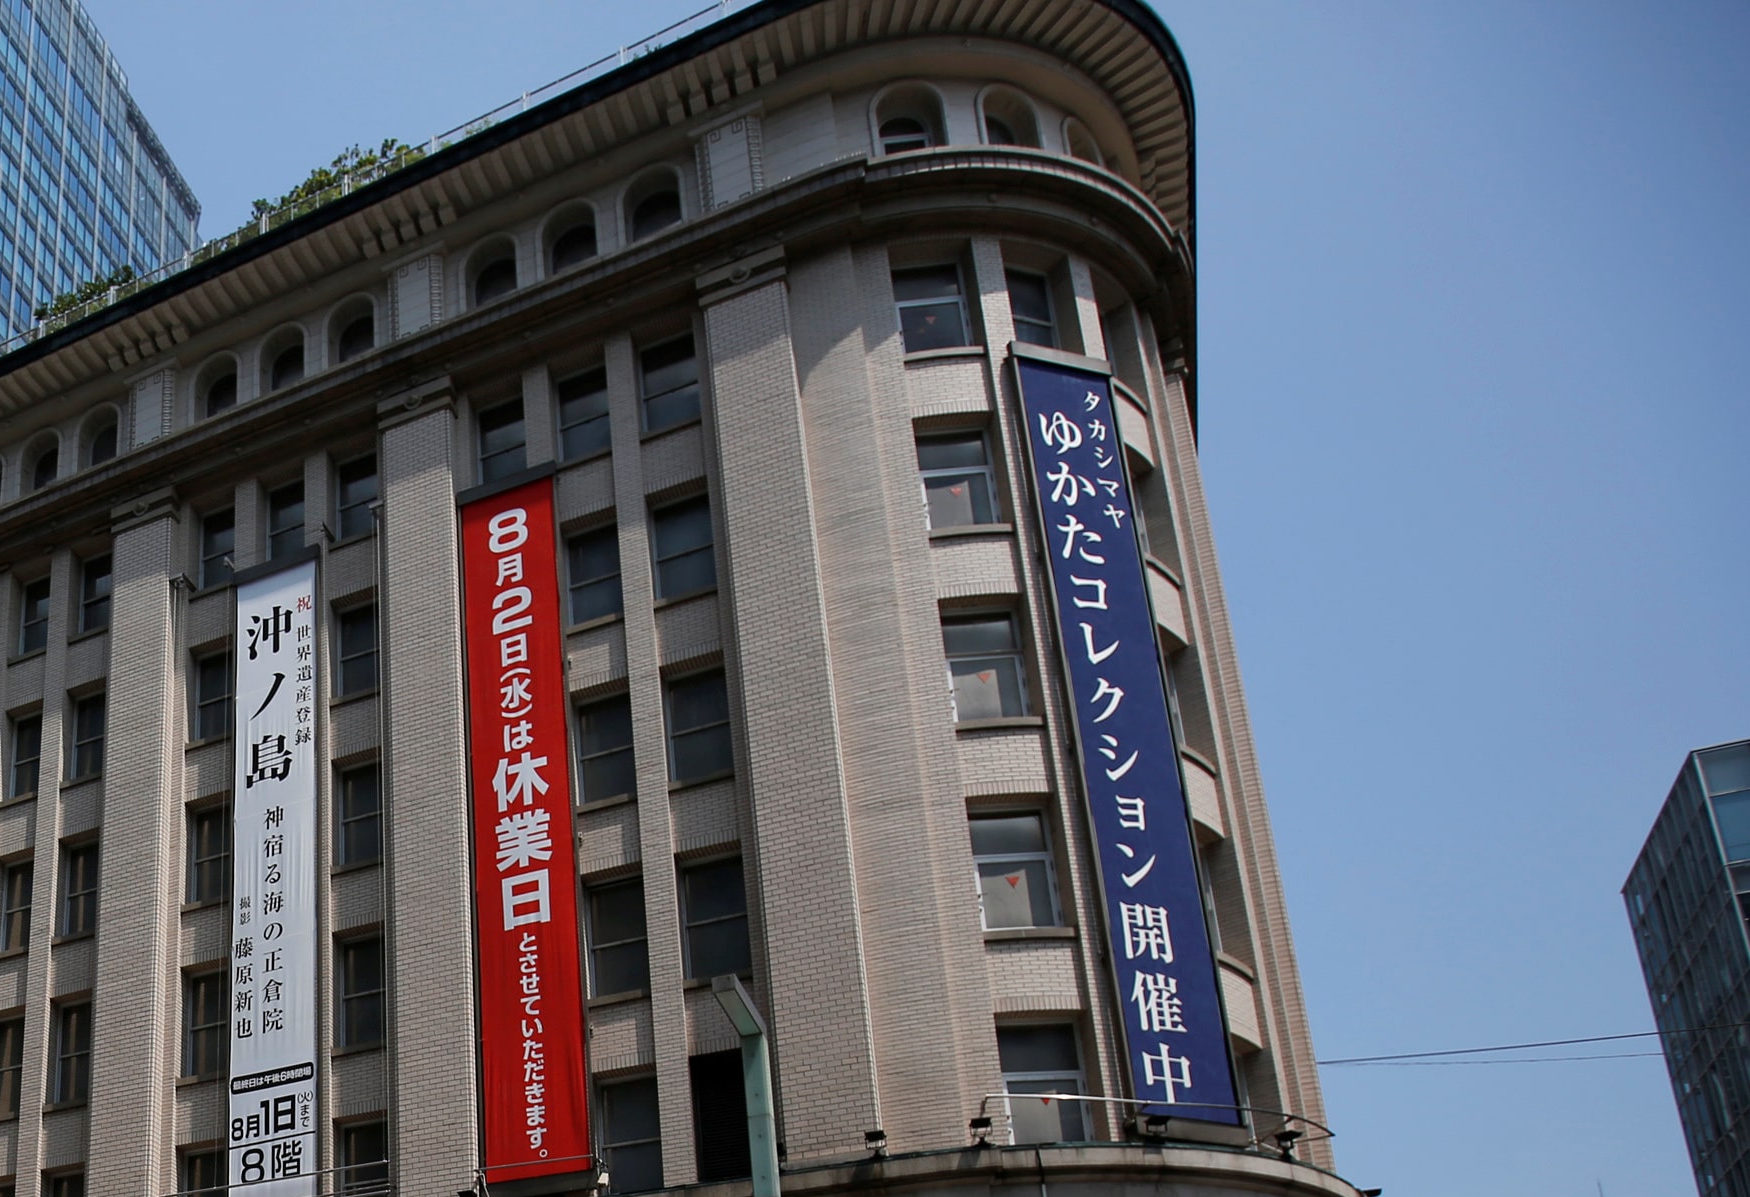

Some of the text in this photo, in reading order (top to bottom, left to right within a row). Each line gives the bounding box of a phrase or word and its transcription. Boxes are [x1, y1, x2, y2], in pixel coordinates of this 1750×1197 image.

[1084, 391, 1125, 529] タカシマヤ
[246, 605, 294, 790] 沖ノ島
[295, 595, 313, 746] 祝 世界遺産登録
[1038, 411, 1192, 1104] ゆかたコレクション開催中
[234, 896, 254, 1040] 撮影 藤原新也
[262, 805, 285, 1035] 神宿る海の正倉院
[241, 1139, 303, 1184] 8階
